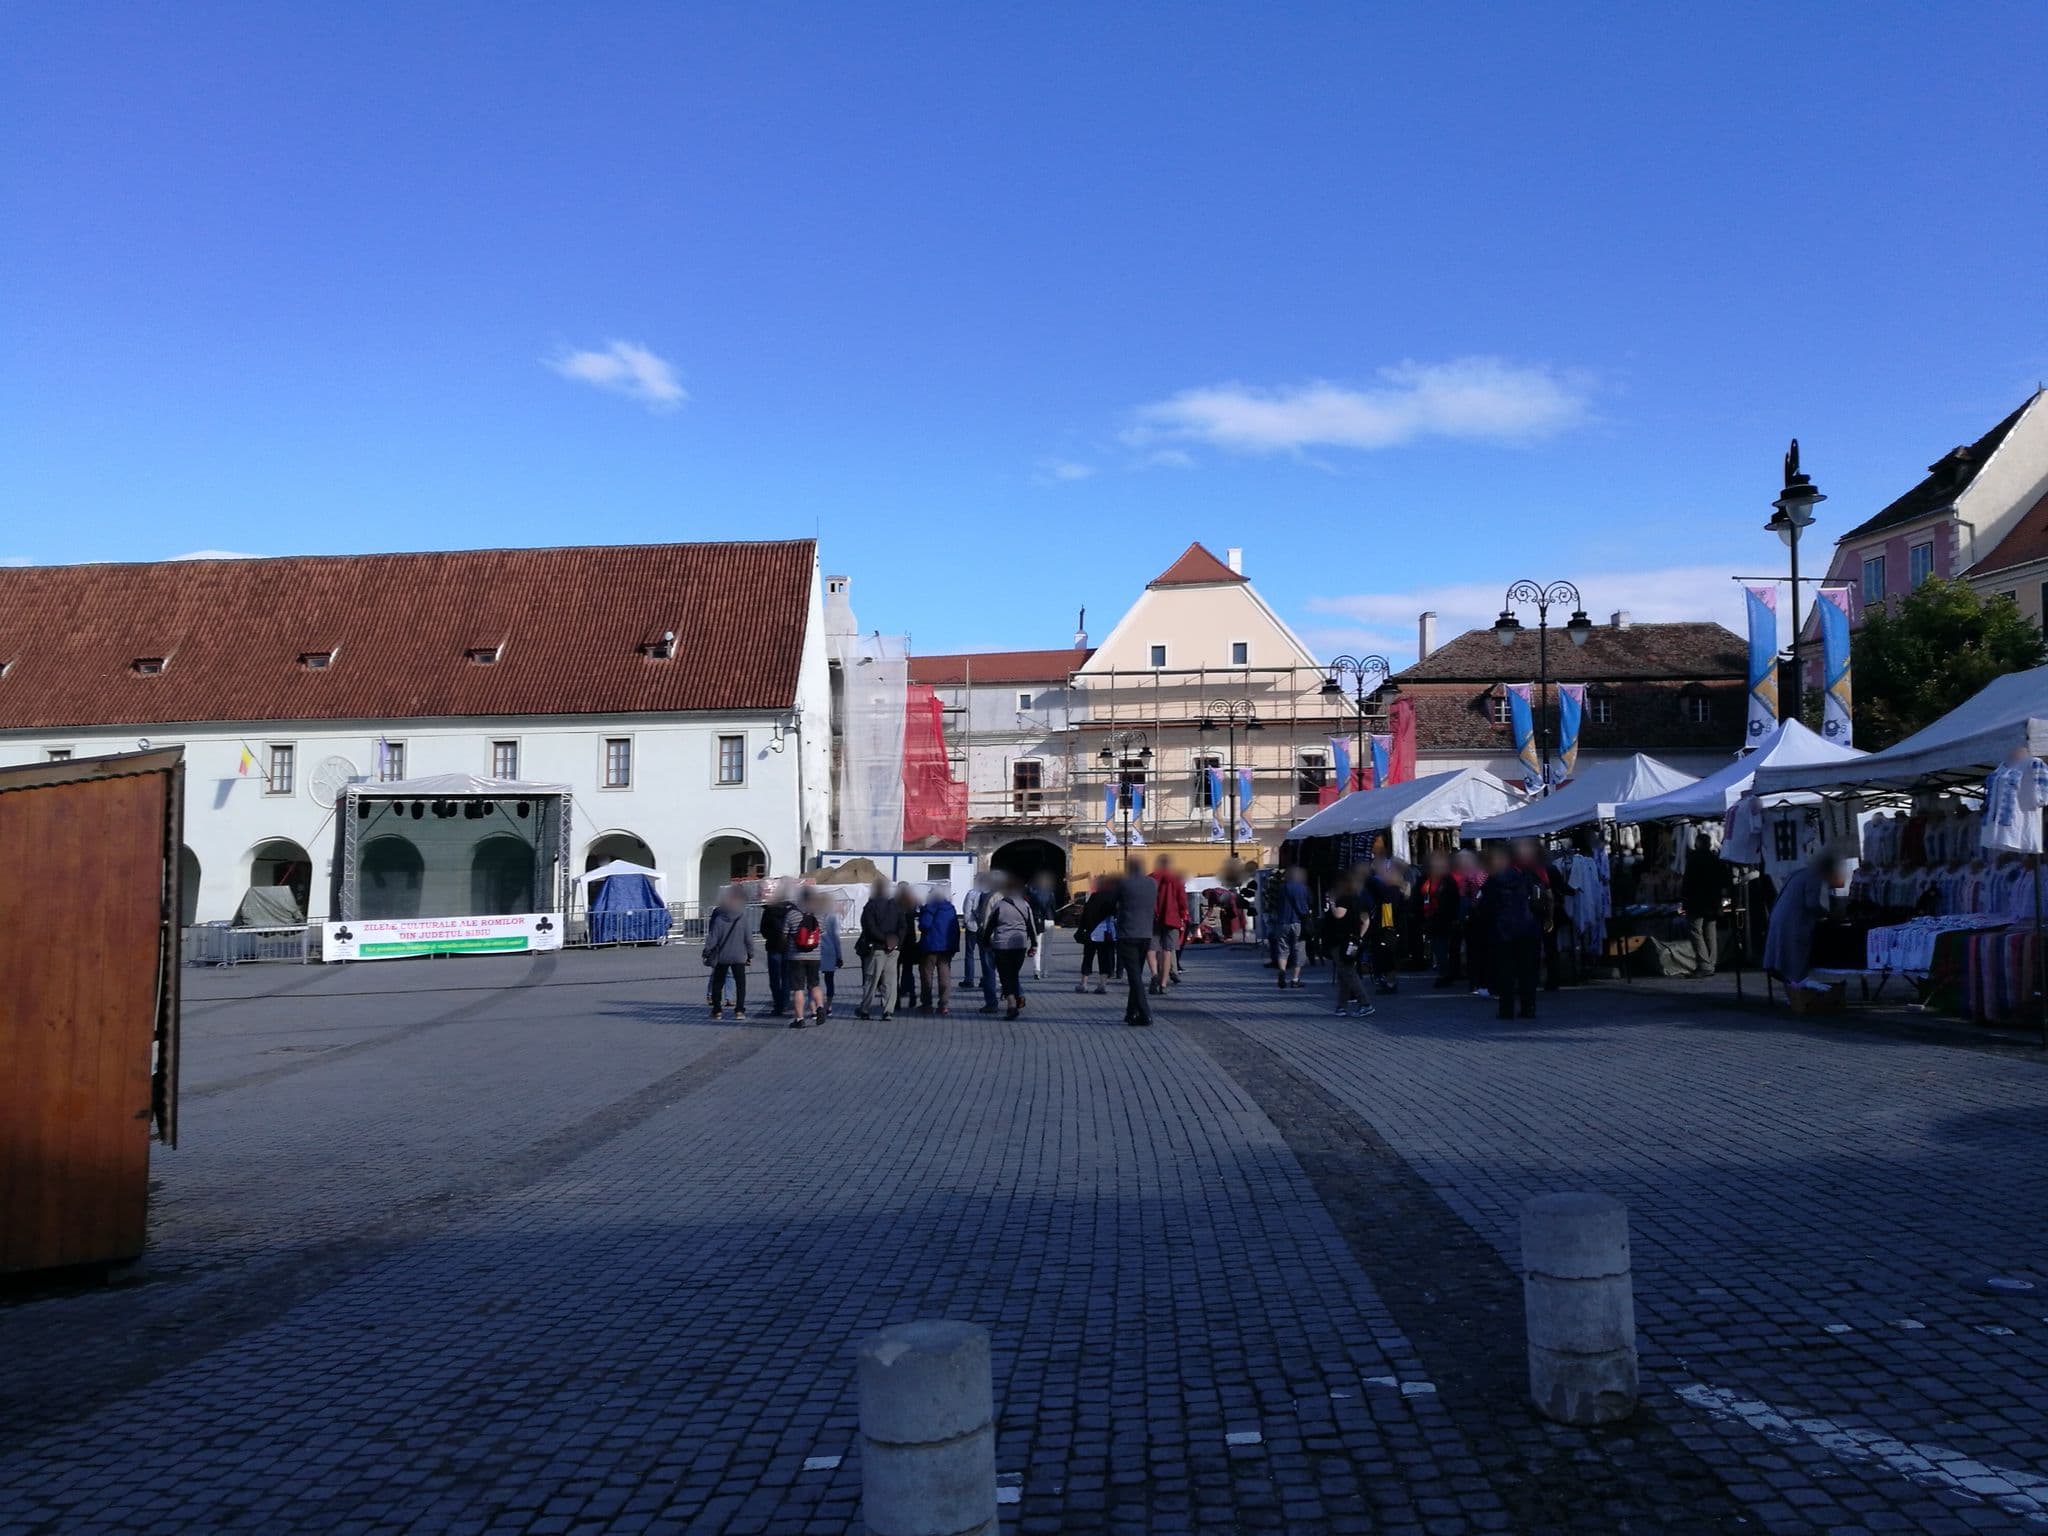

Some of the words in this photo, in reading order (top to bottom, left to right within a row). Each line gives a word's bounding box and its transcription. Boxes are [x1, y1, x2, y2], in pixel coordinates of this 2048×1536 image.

[401, 920, 457, 930] CULTURALE
[460, 919, 478, 928] ALE
[480, 916, 525, 926] ROMILOR
[399, 932, 417, 940] DIN
[465, 929, 491, 937] SIBIU
